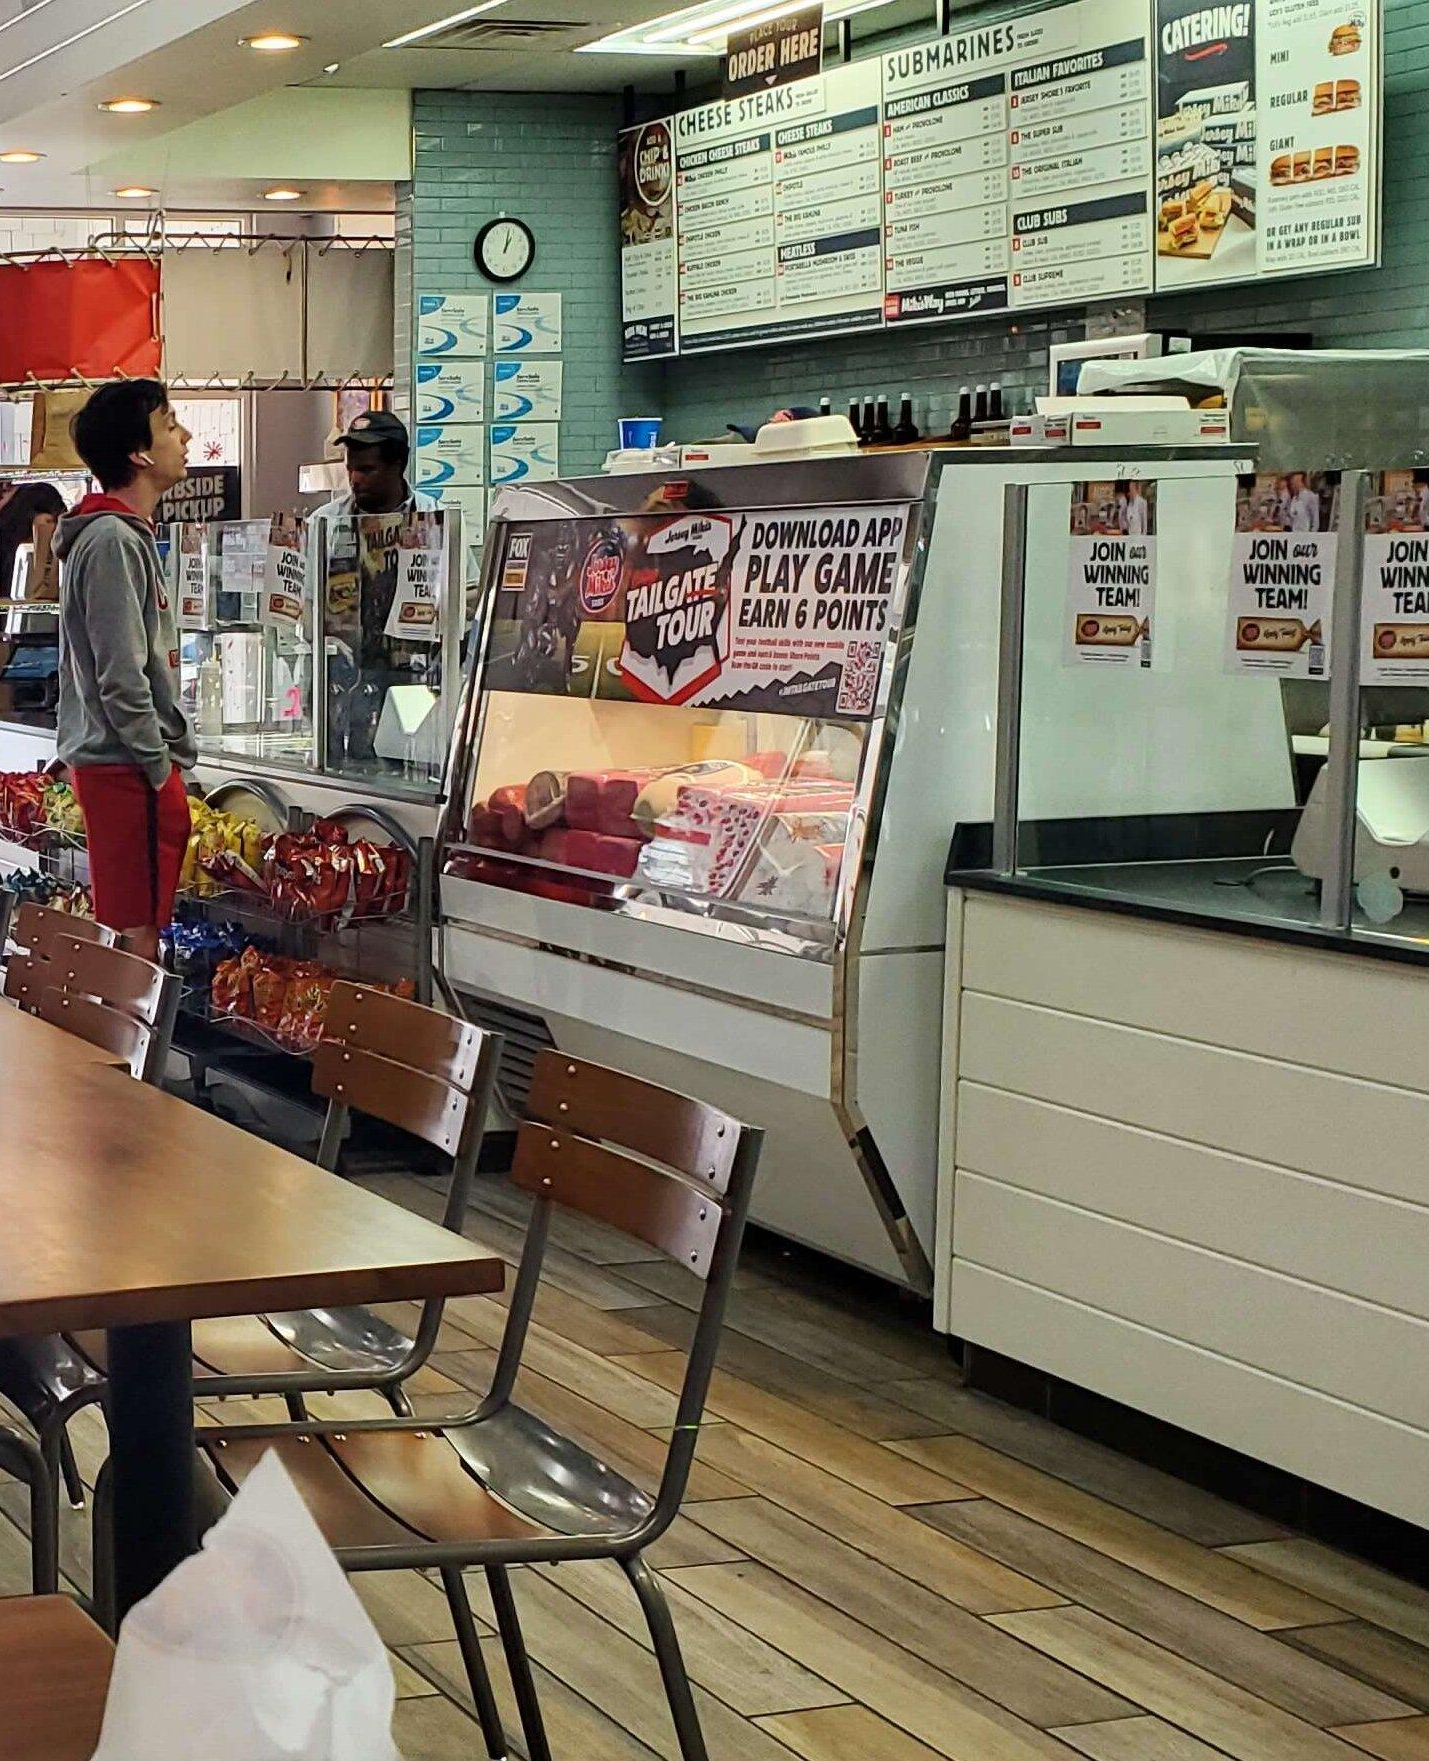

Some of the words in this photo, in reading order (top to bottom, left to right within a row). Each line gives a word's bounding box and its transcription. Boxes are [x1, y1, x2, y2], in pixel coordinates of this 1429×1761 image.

[1163, 4, 1250, 54] CATERING!
[729, 43, 775, 81] ORDER
[780, 27, 819, 67] HERE
[888, 25, 1014, 81] SUBMARINES
[1270, 50, 1289, 64] MINI
[1015, 69, 1050, 87] ITALIAN
[1053, 52, 1103, 76] FAVORITES
[888, 94, 931, 117] AMERICAN
[933, 85, 969, 106] CLASSICS
[1270, 90, 1308, 108] REGULAR
[679, 104, 732, 137] CHEESE
[739, 87, 793, 121] STEAKS
[778, 126, 804, 145] CHEESE
[806, 120, 832, 138] STEAKS
[1270, 137, 1294, 151] GIANT
[640, 147, 659, 164] CHIP
[680, 152, 707, 168] CHICKEN
[735, 138, 760, 155] STEAKS
[1017, 214, 1040, 231] CLUB
[1043, 209, 1067, 226] SUBS
[1267, 228, 1275, 237] OR
[1279, 226, 1291, 235] GET
[1295, 223, 1308, 233] ANY
[1312, 217, 1344, 231] REGULAR
[1347, 215, 1361, 226] SUB
[780, 242, 815, 261] MEATLESS
[1267, 242, 1274, 251] IN
[1285, 237, 1306, 248] WRAP
[1309, 235, 1318, 245] OR
[1321, 234, 1329, 243] IN
[1340, 230, 1360, 241] BOWL
[162, 475, 224, 501] RBSIDE
[163, 498, 224, 521] PICKUP
[367, 527, 400, 551] TAILGA
[665, 529, 689, 544] Jersey
[691, 520, 712, 535] Mike's
[752, 518, 860, 550] DOWNLOAD
[862, 517, 903, 547] APP
[384, 549, 399, 570] TO
[509, 537, 531, 559] FOX
[1090, 542, 1125, 561] JOIN
[1130, 545, 1146, 559] our
[1249, 539, 1288, 561] JOIN
[1293, 543, 1318, 557] our
[1387, 540, 1429, 563] JOIN
[744, 553, 810, 594] PLAY
[814, 552, 897, 594] GAME
[1084, 564, 1149, 585] WINNING
[1243, 563, 1321, 585] WINNING
[1380, 566, 1429, 589] WINN
[627, 562, 720, 623] TAILGATE
[1095, 587, 1140, 607] TEAM!
[1255, 587, 1308, 609] TEAM!
[1393, 592, 1429, 614] TEA
[656, 600, 716, 650] TOUR
[738, 599, 790, 628] EARN
[795, 599, 808, 629] 6
[813, 599, 888, 632] POINTS
[746, 639, 756, 647] your
[758, 638, 777, 646] football
[826, 641, 845, 649] mobile
